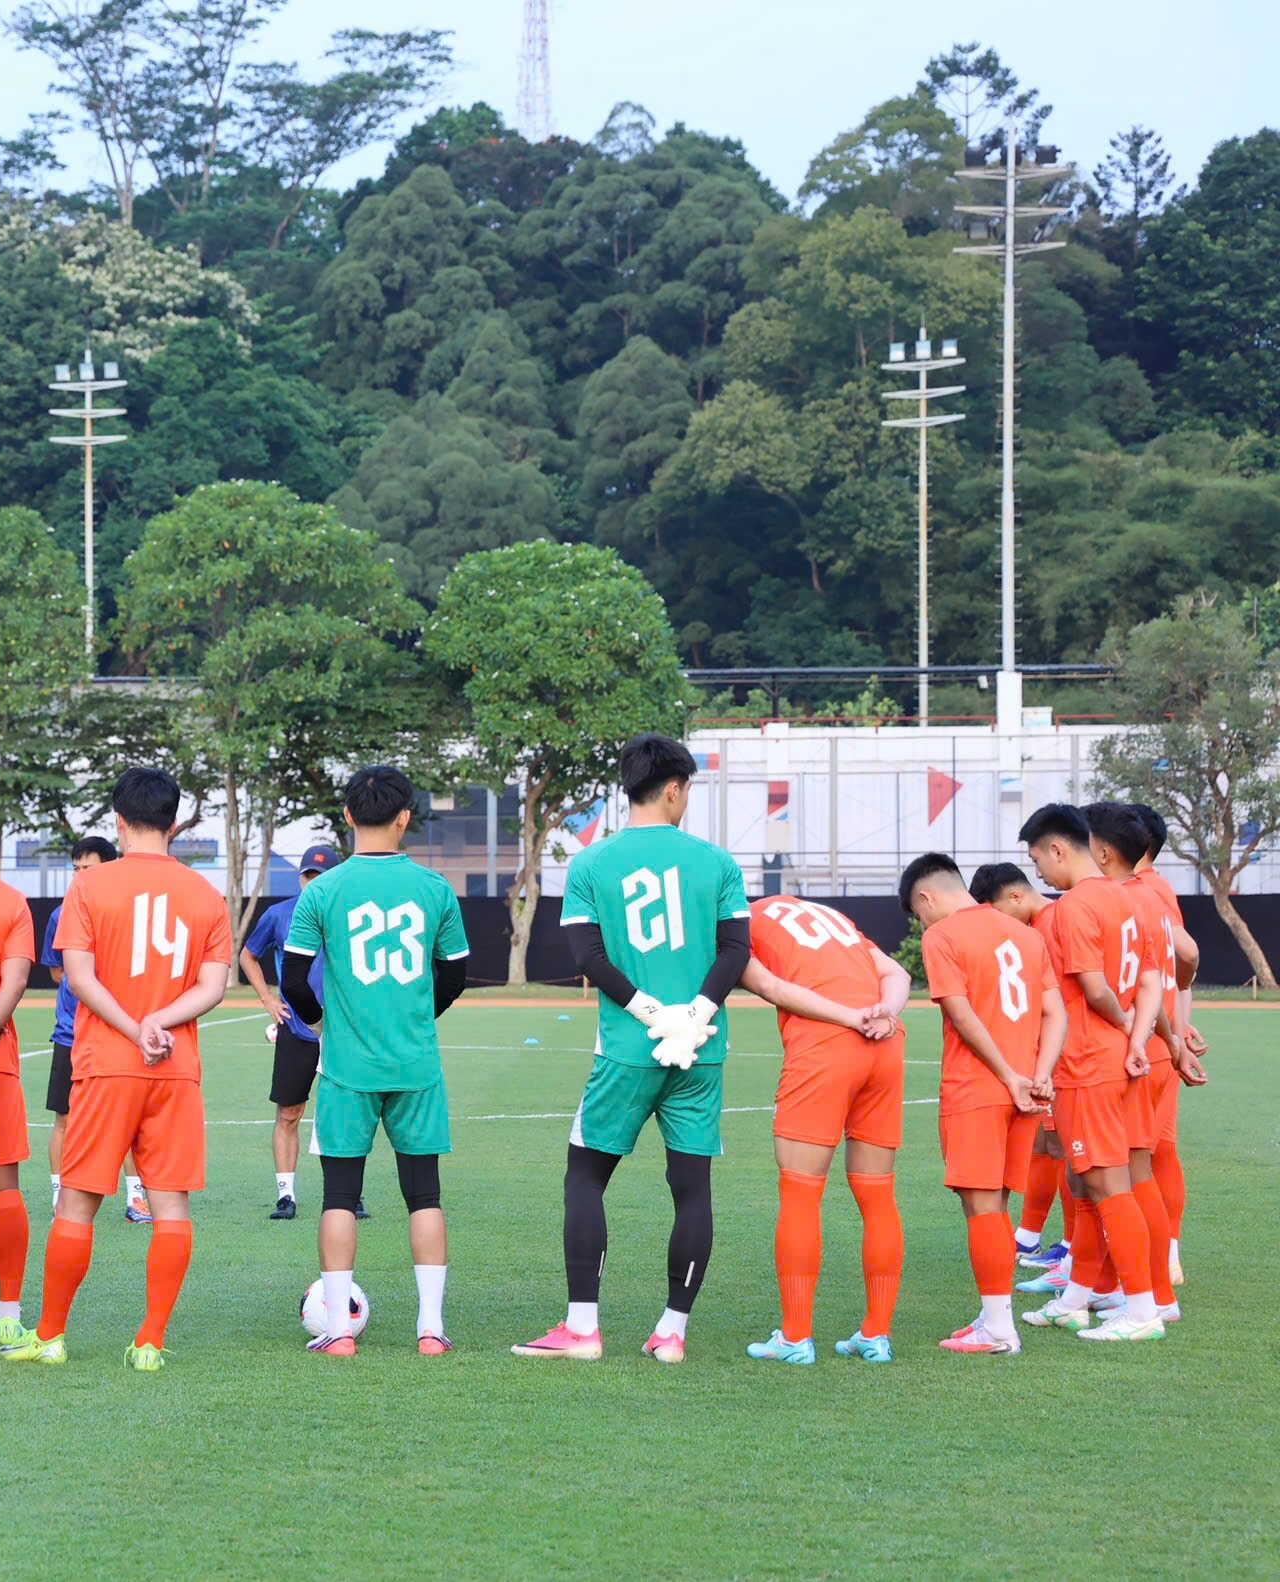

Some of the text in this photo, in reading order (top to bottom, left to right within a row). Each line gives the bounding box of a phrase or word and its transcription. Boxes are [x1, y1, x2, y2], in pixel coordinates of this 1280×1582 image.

[130, 892, 189, 979] 14
[347, 899, 425, 985] 23
[621, 865, 685, 953] 21
[762, 900, 861, 951] 20
[994, 938, 1029, 1023] 8
[1118, 915, 1140, 994] 6
